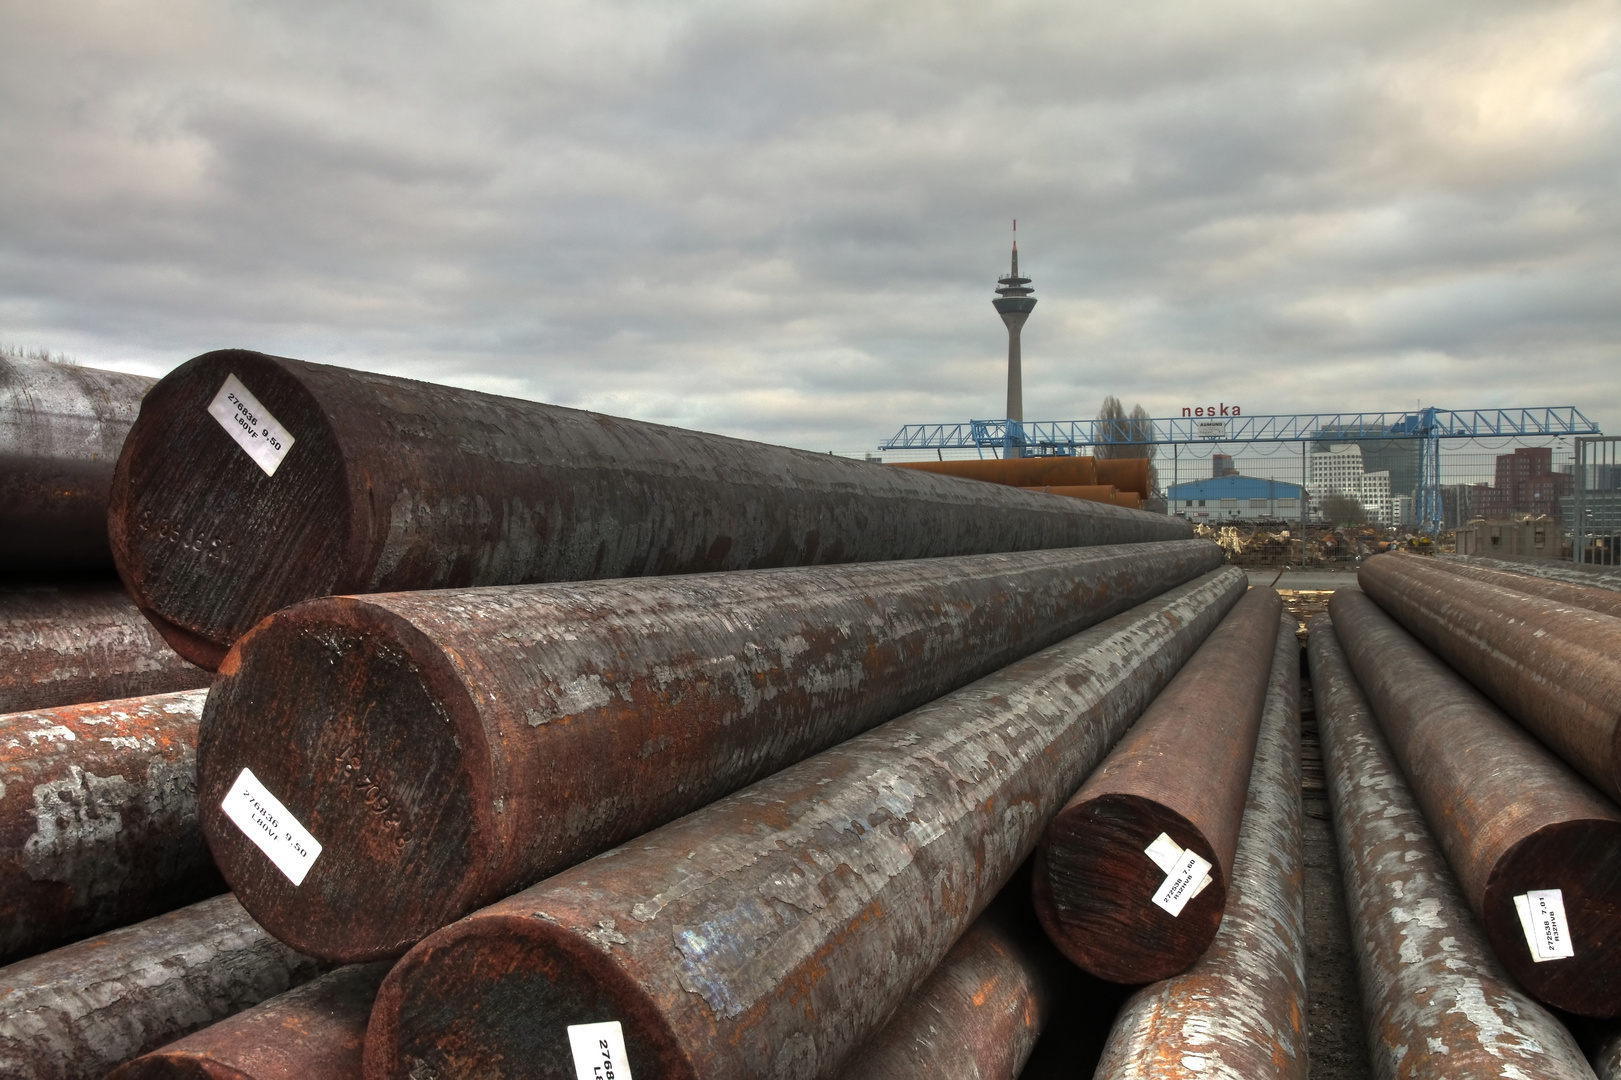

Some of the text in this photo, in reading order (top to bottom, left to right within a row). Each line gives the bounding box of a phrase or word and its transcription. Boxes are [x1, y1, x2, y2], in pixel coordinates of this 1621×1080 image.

[227, 392, 258, 426] 276836
[1182, 402, 1240, 417] neska
[243, 789, 279, 828] 276836
[1163, 878, 1183, 903] 272538
[1543, 920, 1555, 951] 272538
[599, 1039, 615, 1080] 2768
